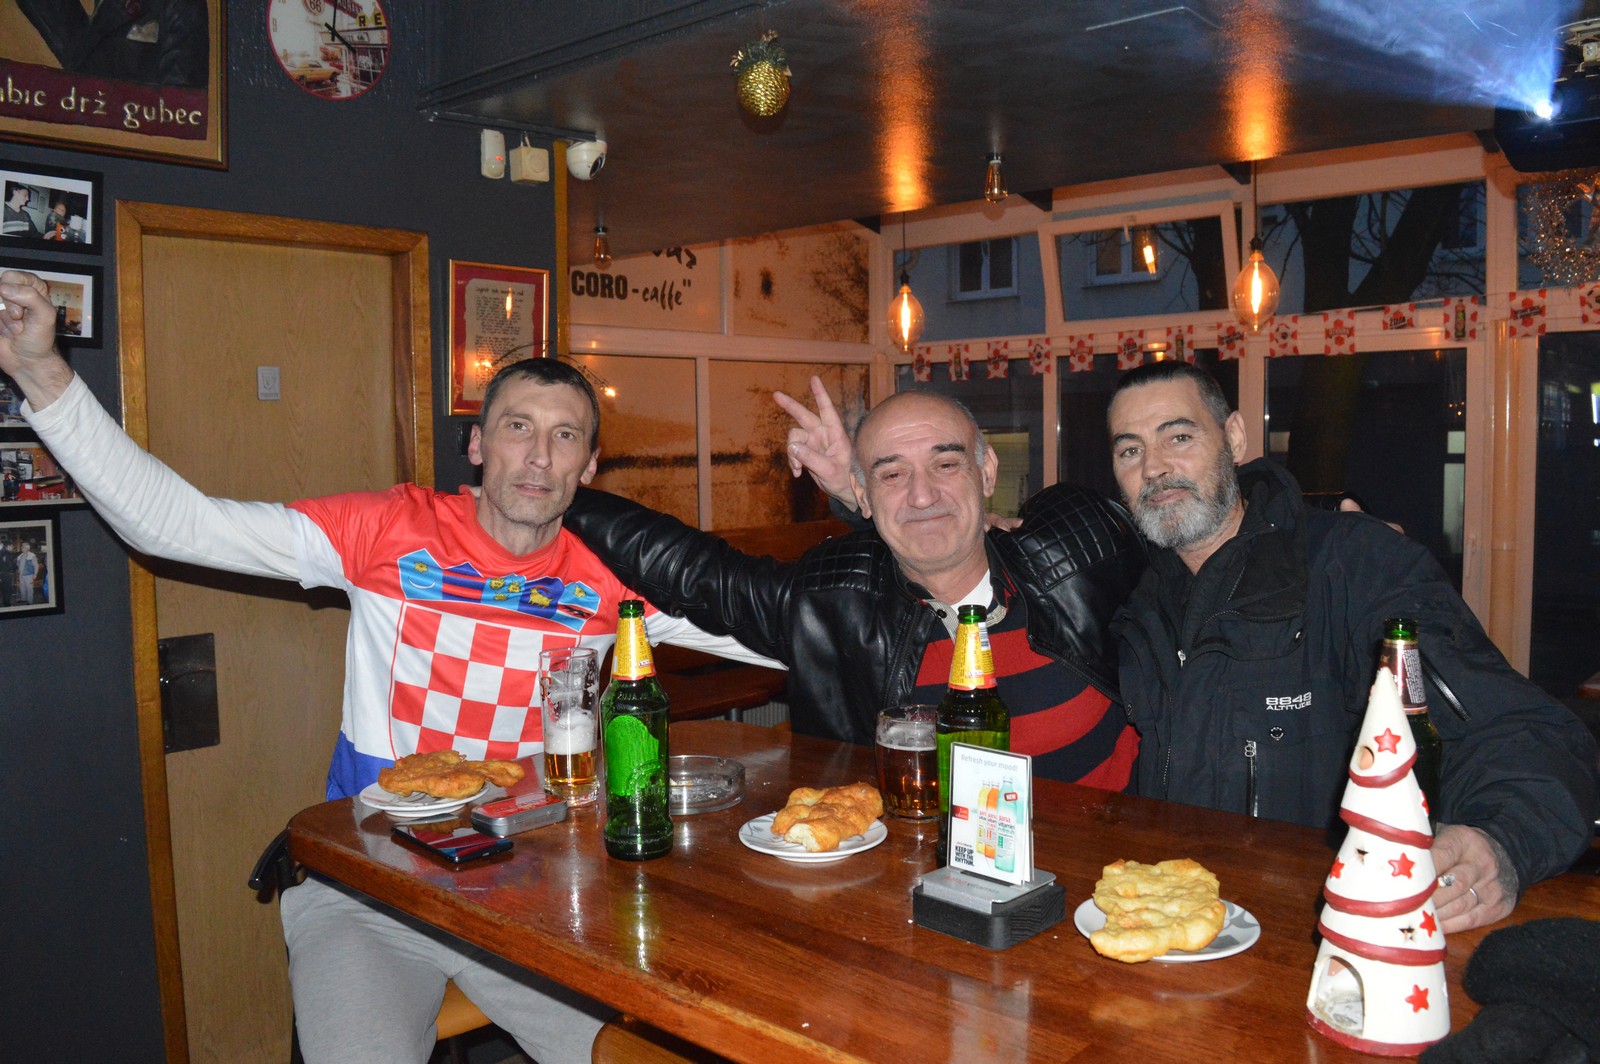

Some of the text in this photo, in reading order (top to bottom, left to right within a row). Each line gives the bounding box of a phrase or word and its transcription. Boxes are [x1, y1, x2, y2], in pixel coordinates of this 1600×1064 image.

[374, 13, 382, 25] E
[60, 86, 107, 115] drž
[123, 97, 202, 129] gubec
[1266, 691, 1312, 705] 8848
[1266, 700, 1312, 710] ALTITUDE
[961, 754, 983, 765] Refresh
[983, 759, 998, 768] your
[955, 845, 967, 853] KEEP
